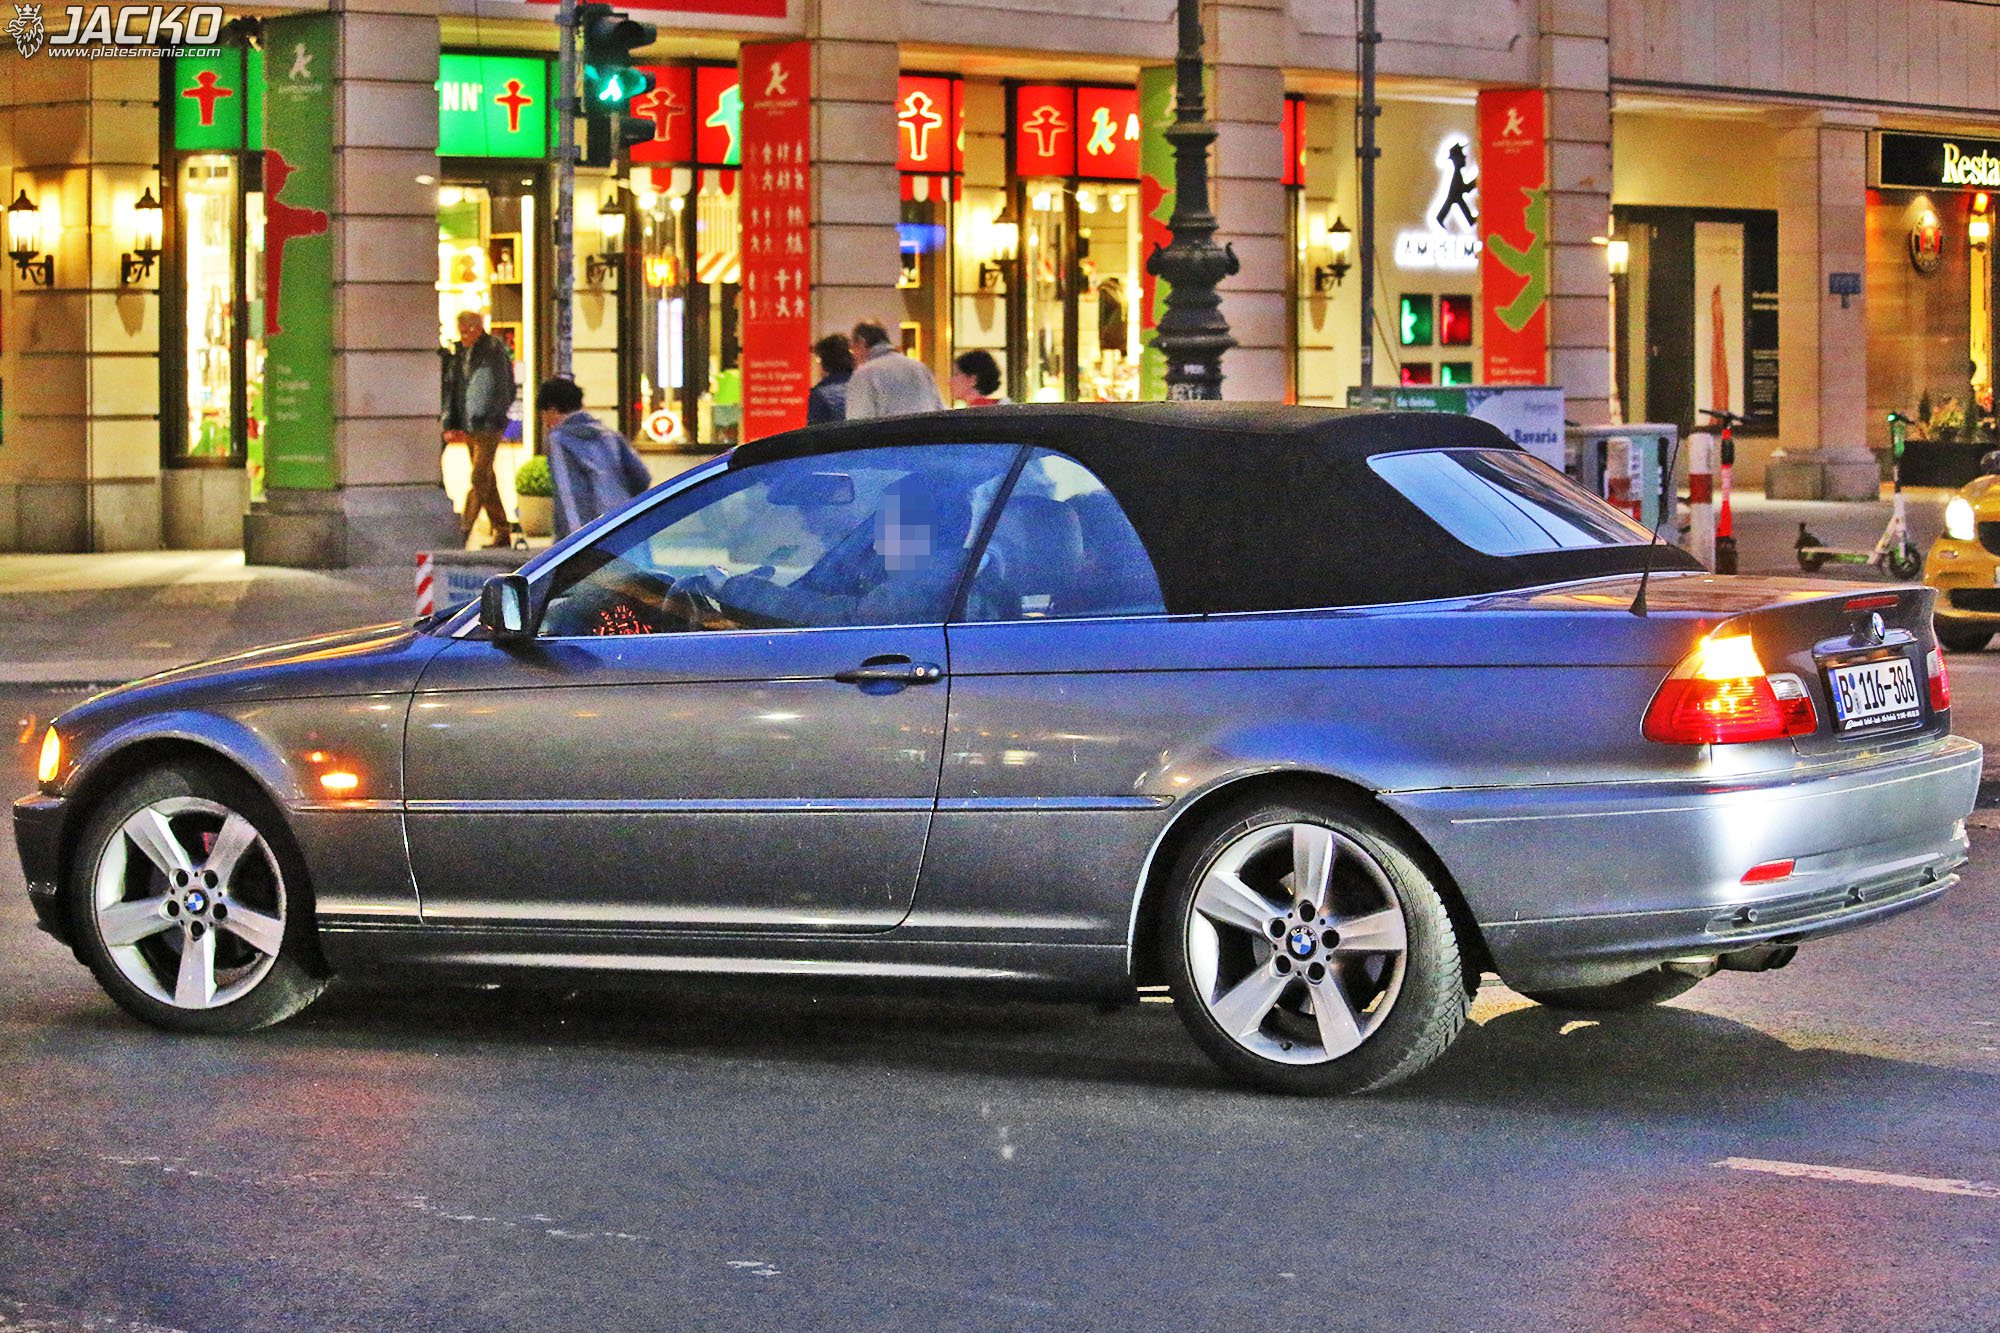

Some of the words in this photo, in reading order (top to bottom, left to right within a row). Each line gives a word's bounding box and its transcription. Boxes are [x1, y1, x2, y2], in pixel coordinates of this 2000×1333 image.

[1514, 428, 1558, 444] Bavaria
[1838, 674, 1853, 714] B
[1859, 665, 1915, 710] 116-386
